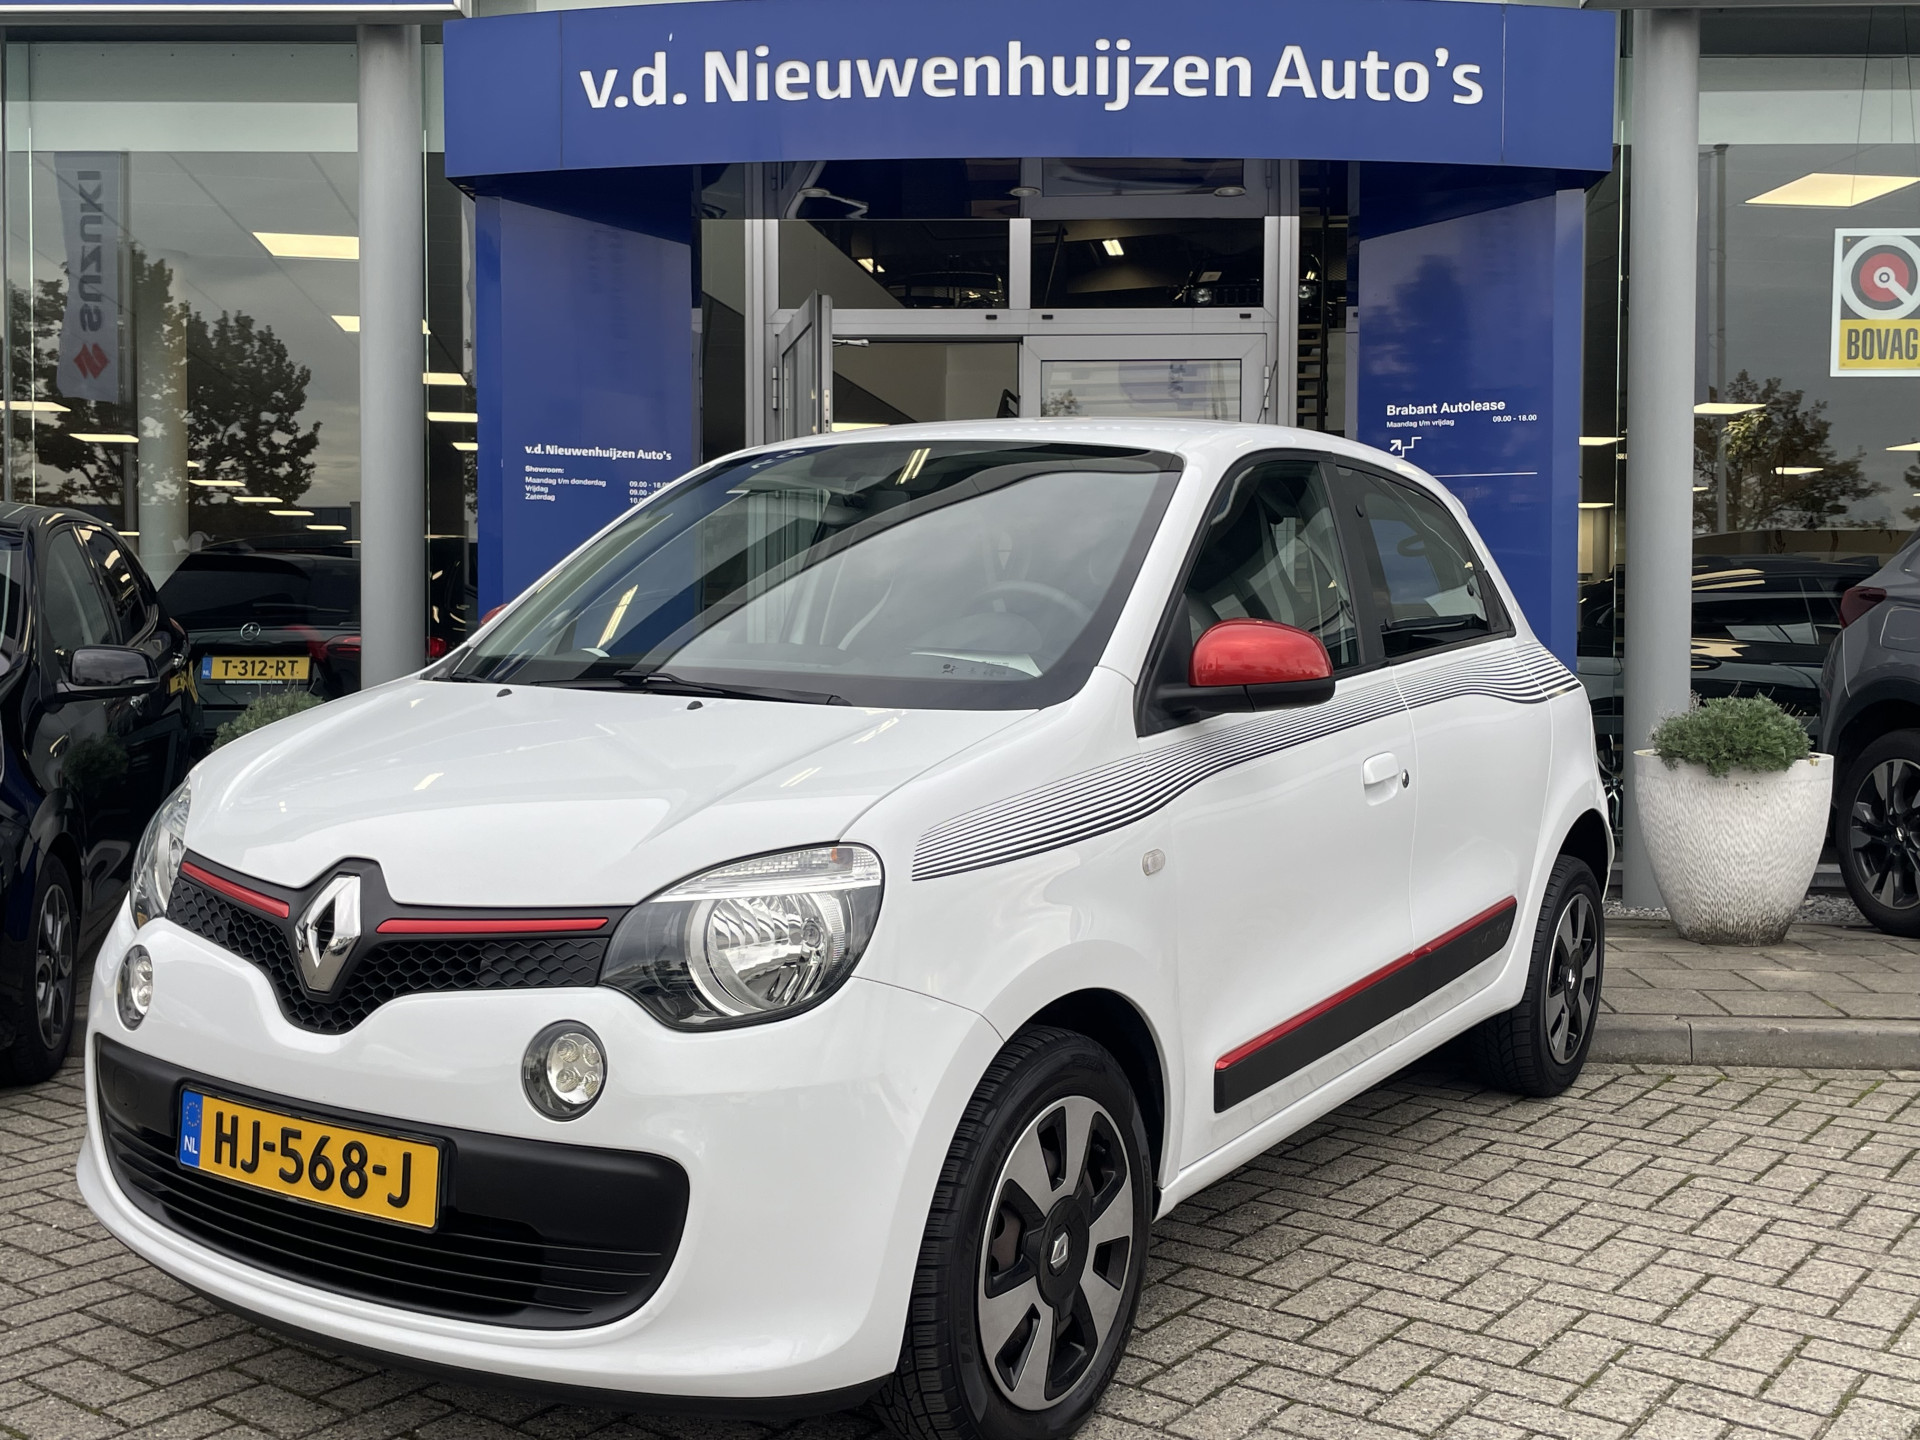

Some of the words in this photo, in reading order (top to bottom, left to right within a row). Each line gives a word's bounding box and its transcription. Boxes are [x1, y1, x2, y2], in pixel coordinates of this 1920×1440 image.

[579, 51, 688, 109] v.d.
[703, 39, 1252, 112] Nieuwenhuijzen
[1267, 45, 1484, 105] Auto's
[1846, 328, 1919, 361] BOVAG
[1386, 404, 1438, 416] Brabant
[1440, 400, 1506, 414] Autolease
[1432, 418, 1455, 427] vrijdag
[1492, 415, 1512, 423] 09.00
[1518, 414, 1538, 422] 18.00
[525, 443, 545, 455] v.d.
[545, 444, 636, 461] Nieuwenhuijzen
[637, 449, 672, 461] Auto's
[525, 465, 565, 474] Showroom:
[525, 476, 557, 486] Maandag
[570, 478, 607, 488] donderdag
[629, 480, 648, 488] 09.00
[525, 485, 549, 494] Vrijdag
[525, 492, 556, 502] Zaterdag
[222, 660, 298, 676] T-312-RT
[183, 1135, 198, 1154] NL
[213, 1111, 412, 1208] HJ-568-J
